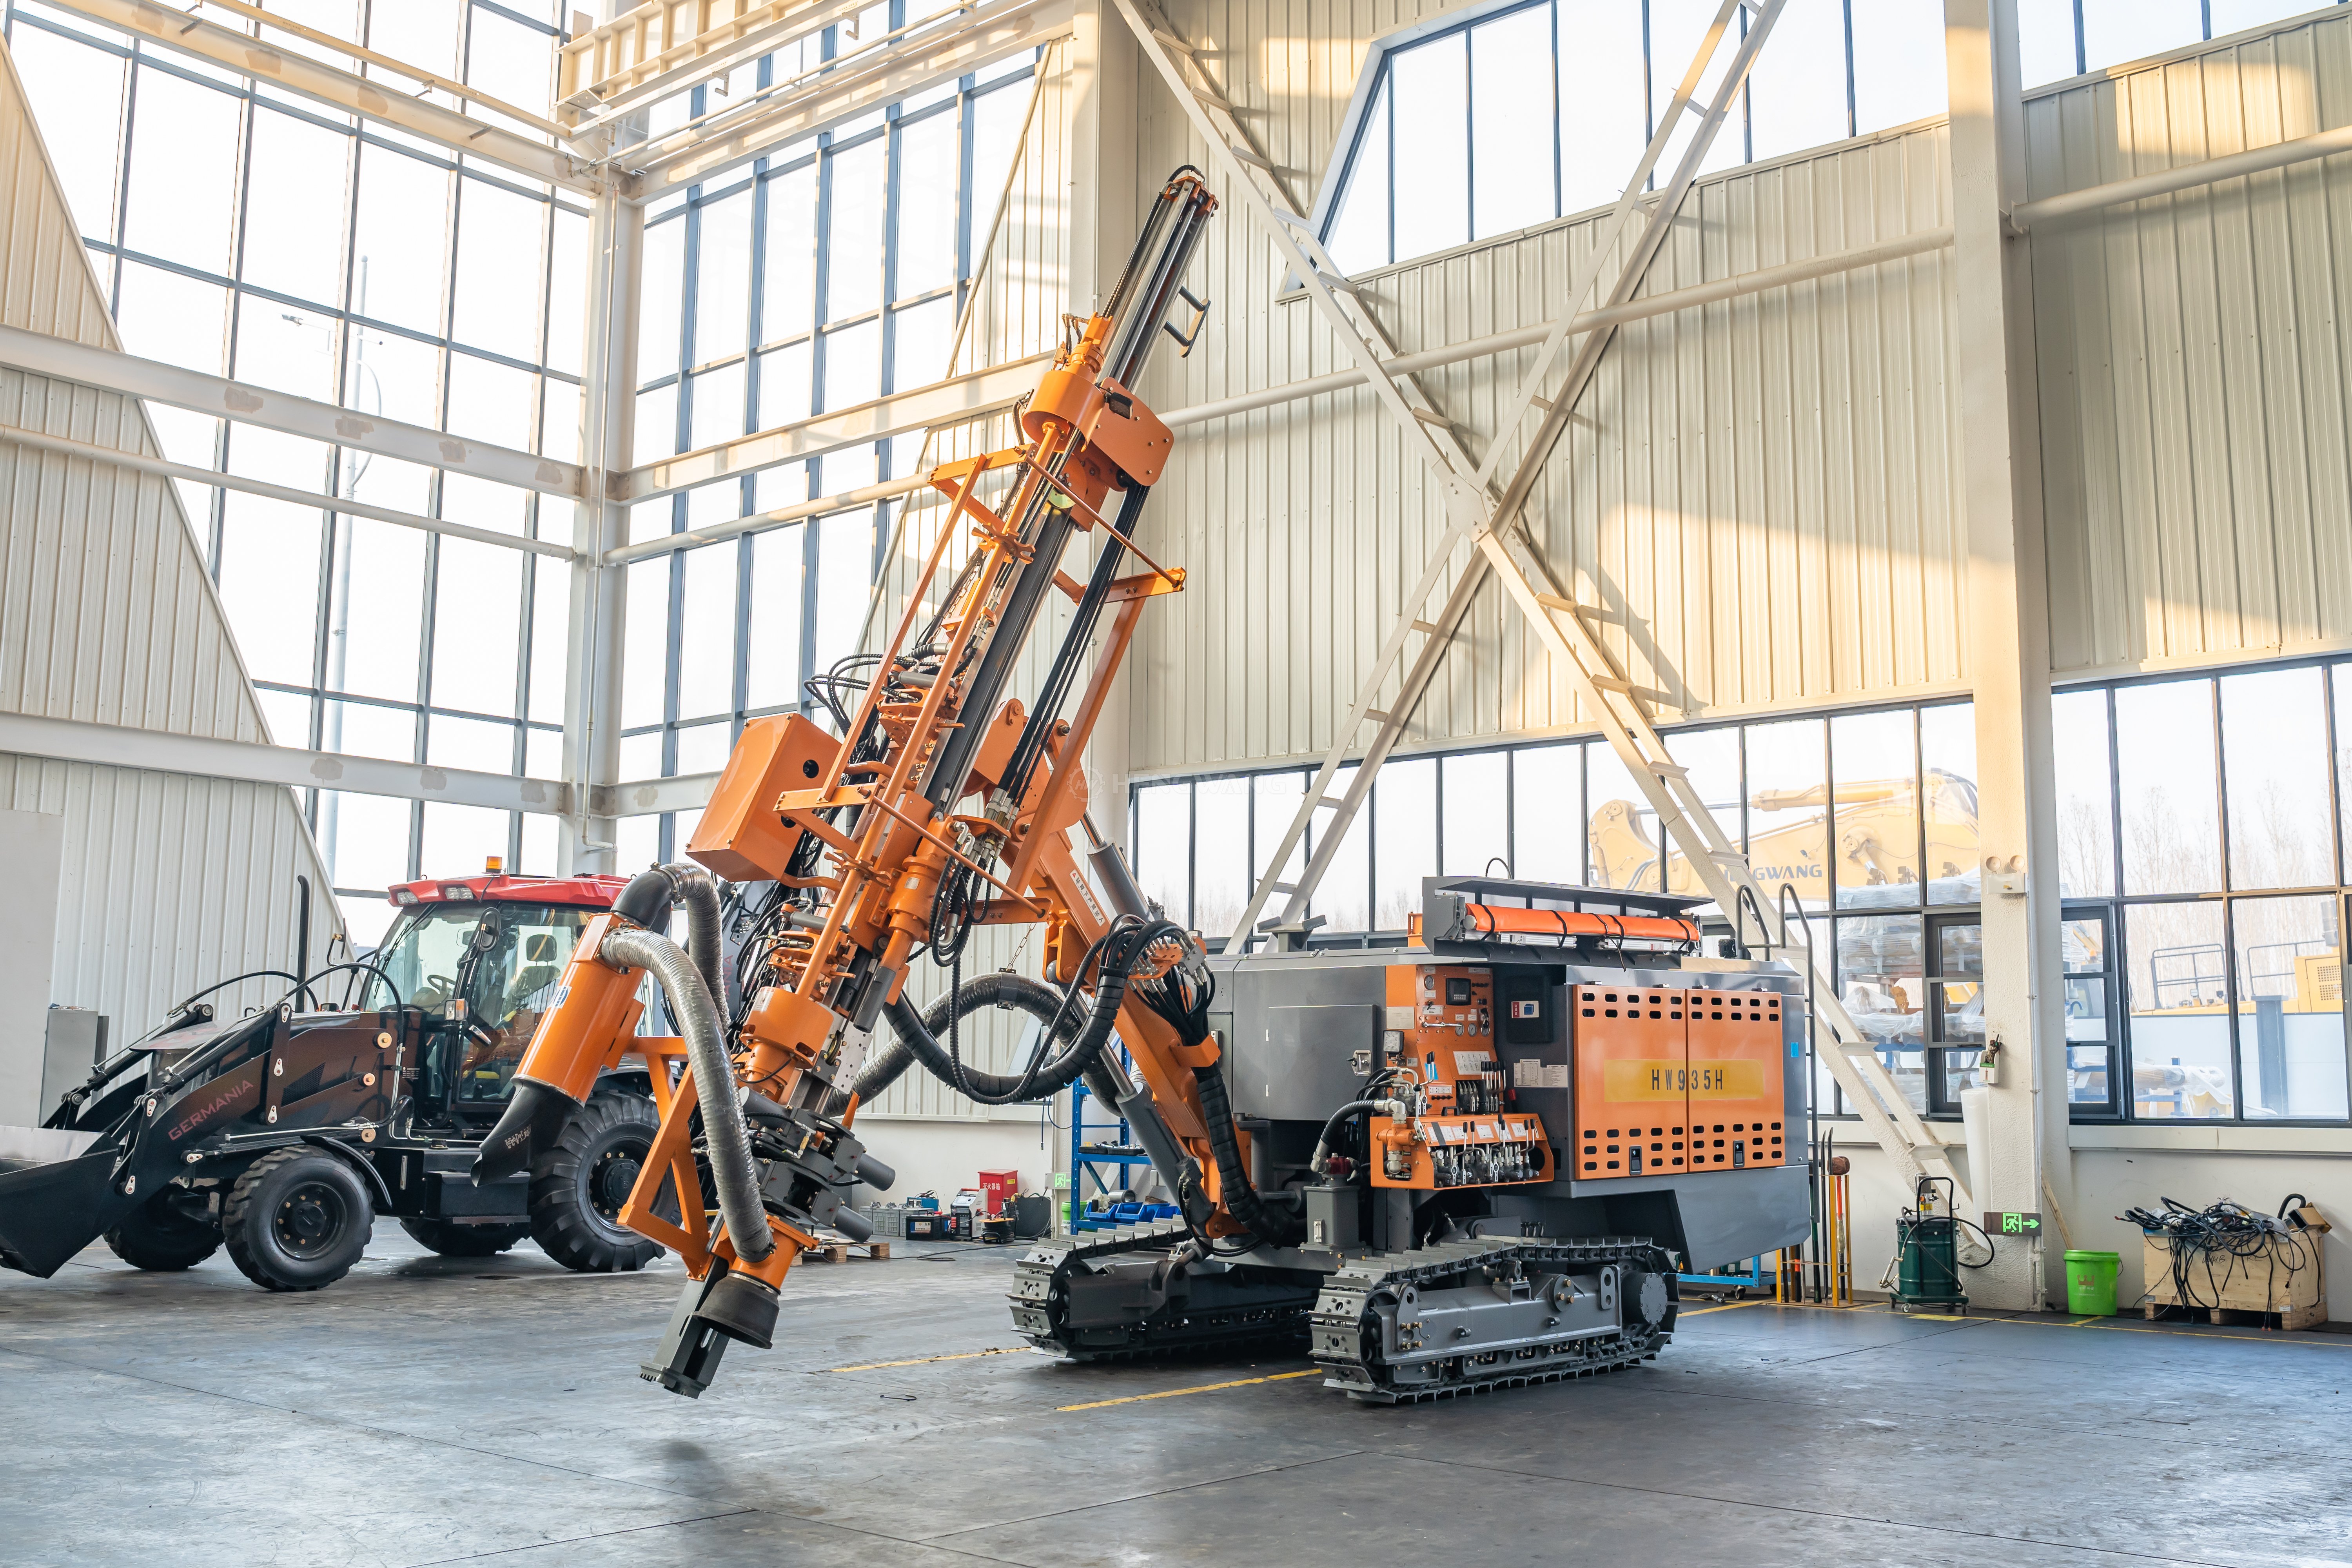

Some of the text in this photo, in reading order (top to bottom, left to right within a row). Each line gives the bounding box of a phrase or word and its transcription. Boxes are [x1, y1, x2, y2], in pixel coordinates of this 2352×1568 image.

[1724, 864, 1822, 882] GWANG
[1652, 1069, 1722, 1091] HW935H
[168, 1080, 254, 1141] GERMANIA
